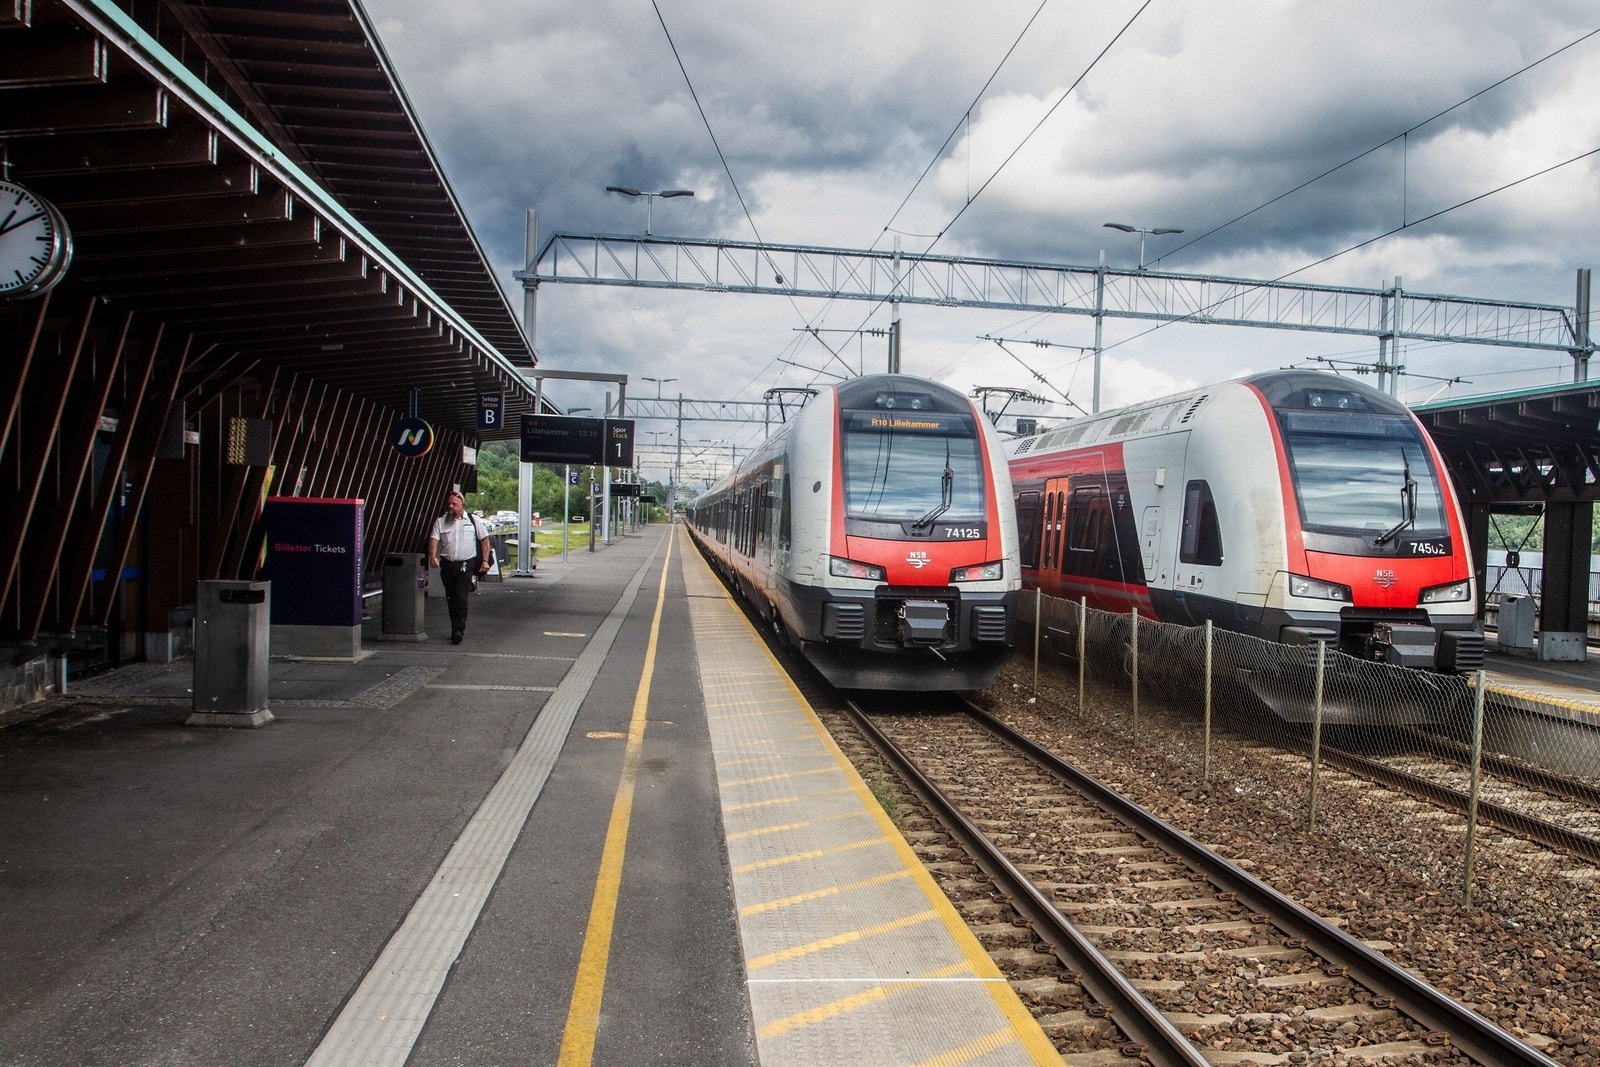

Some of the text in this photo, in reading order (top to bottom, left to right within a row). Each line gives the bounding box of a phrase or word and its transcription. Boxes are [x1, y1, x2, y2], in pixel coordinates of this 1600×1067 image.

[485, 409, 495, 424] B
[871, 418, 940, 429] R10 Lillehammer
[527, 427, 570, 437] Lillehammer
[615, 443, 621, 458] 1
[945, 528, 980, 538] 74125
[274, 543, 346, 553] Billetter Tickets
[909, 551, 927, 559] NSB
[1376, 569, 1394, 577] NSB
